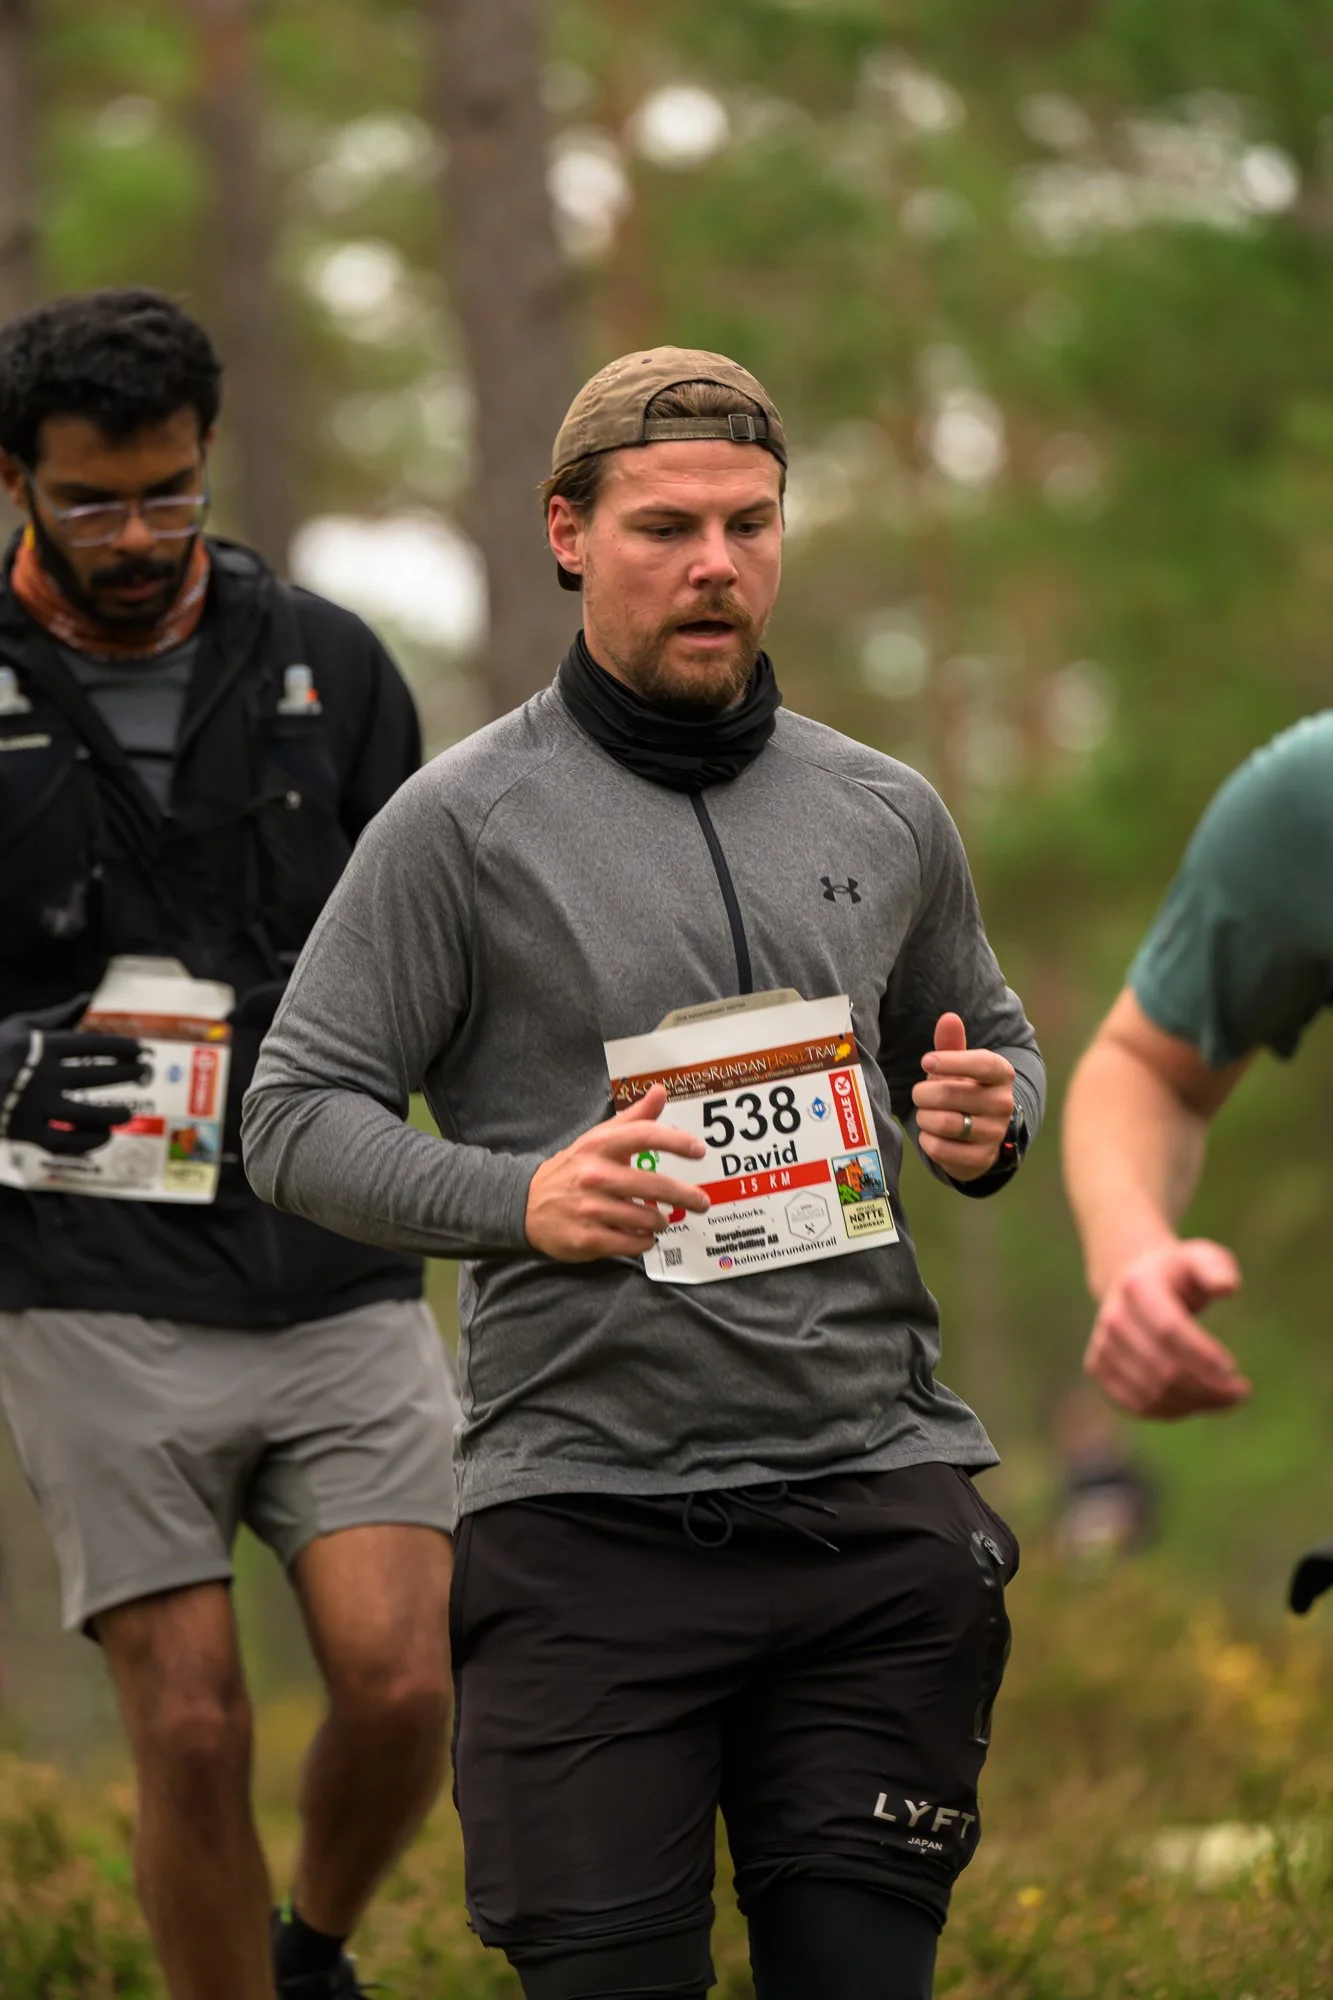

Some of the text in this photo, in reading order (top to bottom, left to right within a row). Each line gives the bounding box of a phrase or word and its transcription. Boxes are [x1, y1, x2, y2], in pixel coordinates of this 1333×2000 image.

[703, 1086, 801, 1148] 538
[840, 1096, 860, 1144] CIRCLE
[720, 1139, 799, 1177] David
[739, 1171, 791, 1195] 15 KM
[734, 1236, 837, 1266] kolmardsrundantrail
[873, 1791, 976, 1839] LYFT
[907, 1837, 943, 1851] JAPAN
